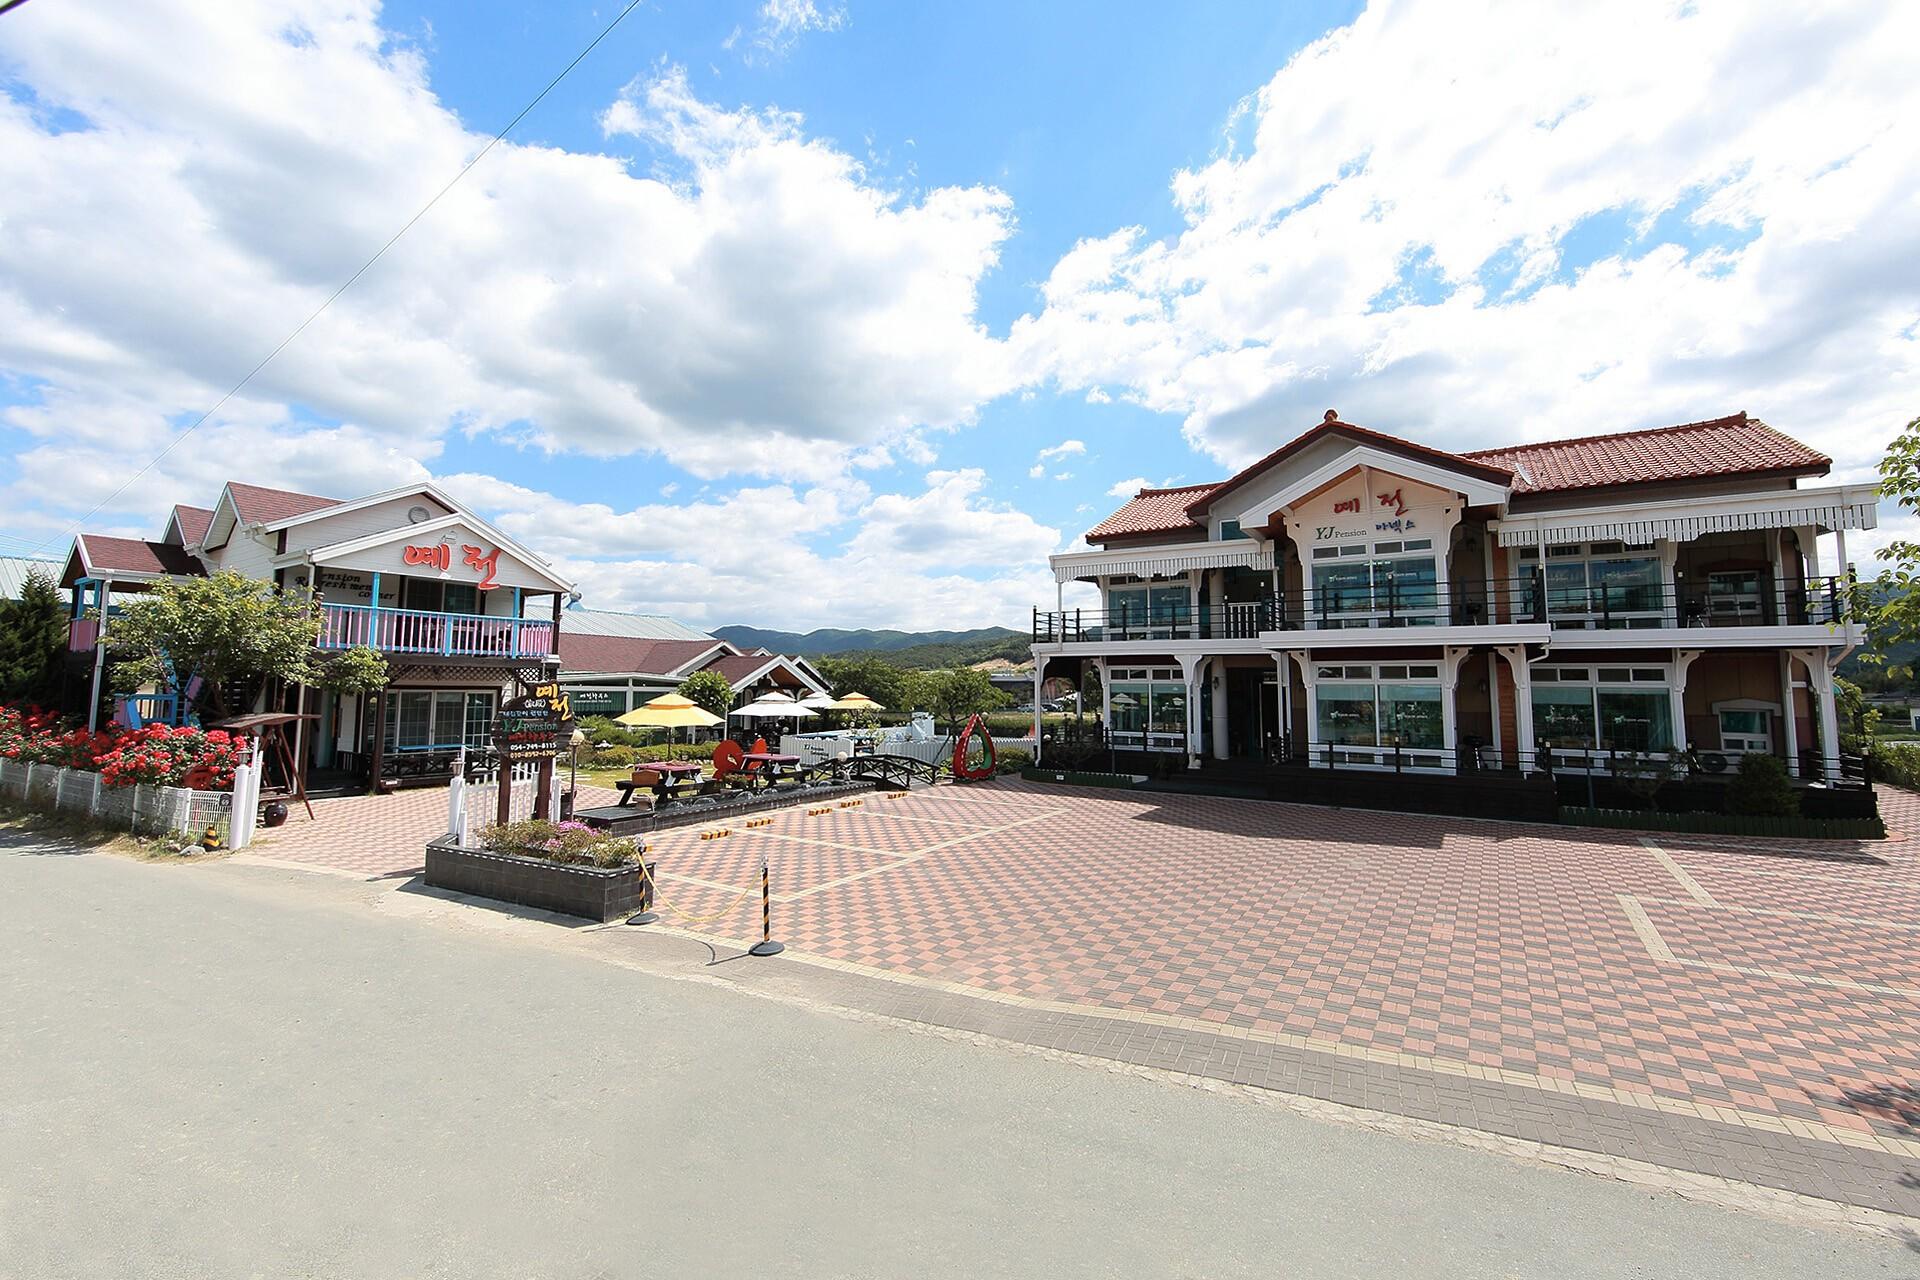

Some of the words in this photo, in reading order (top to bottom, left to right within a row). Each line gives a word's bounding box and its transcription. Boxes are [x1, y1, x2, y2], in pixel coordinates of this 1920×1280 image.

[1315, 526, 1335, 540] YJ
[1335, 529, 1367, 538] Pension
[358, 590, 396, 600] coner
[522, 722, 558, 732] Pension
